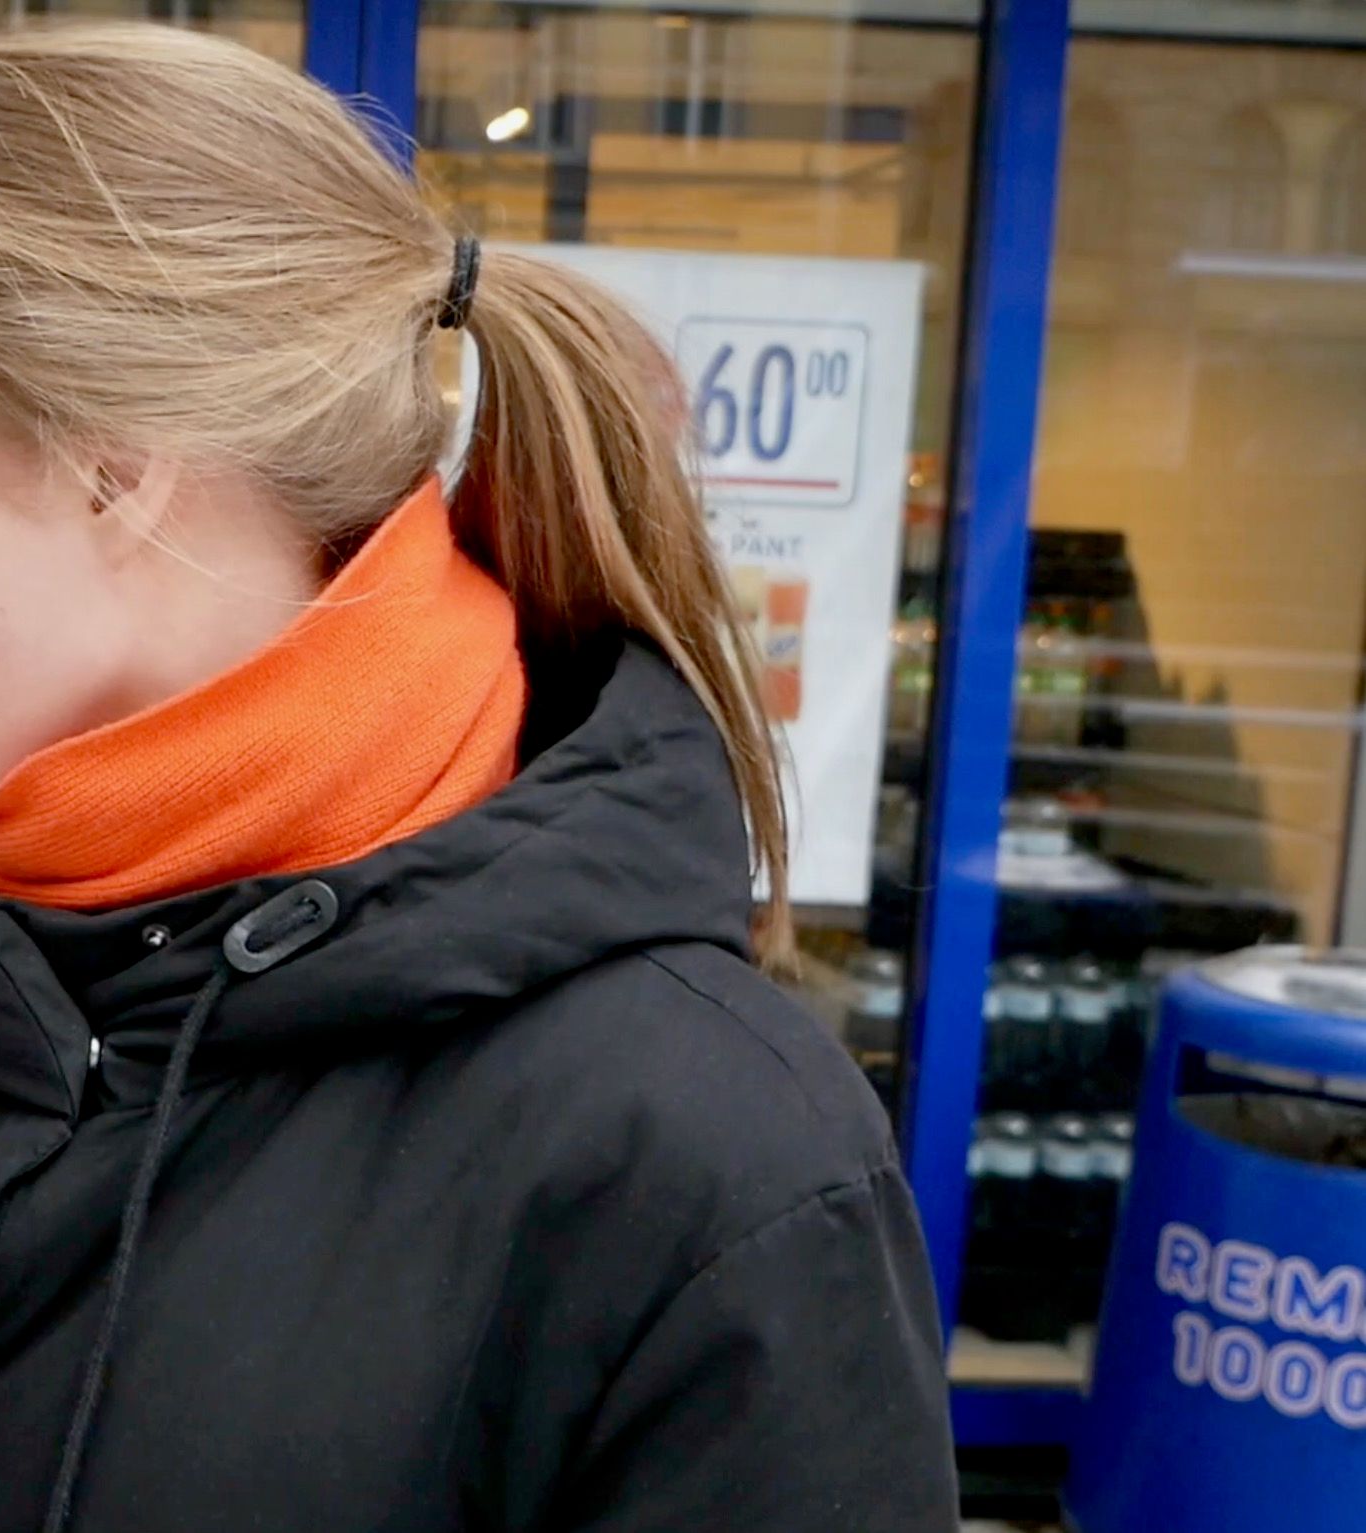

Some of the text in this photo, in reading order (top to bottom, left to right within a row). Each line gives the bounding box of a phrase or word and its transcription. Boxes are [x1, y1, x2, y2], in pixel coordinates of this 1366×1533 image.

[731, 532, 803, 558] PANT
[1155, 1220, 1366, 1345] REM
[1172, 1309, 1366, 1431] 1000
